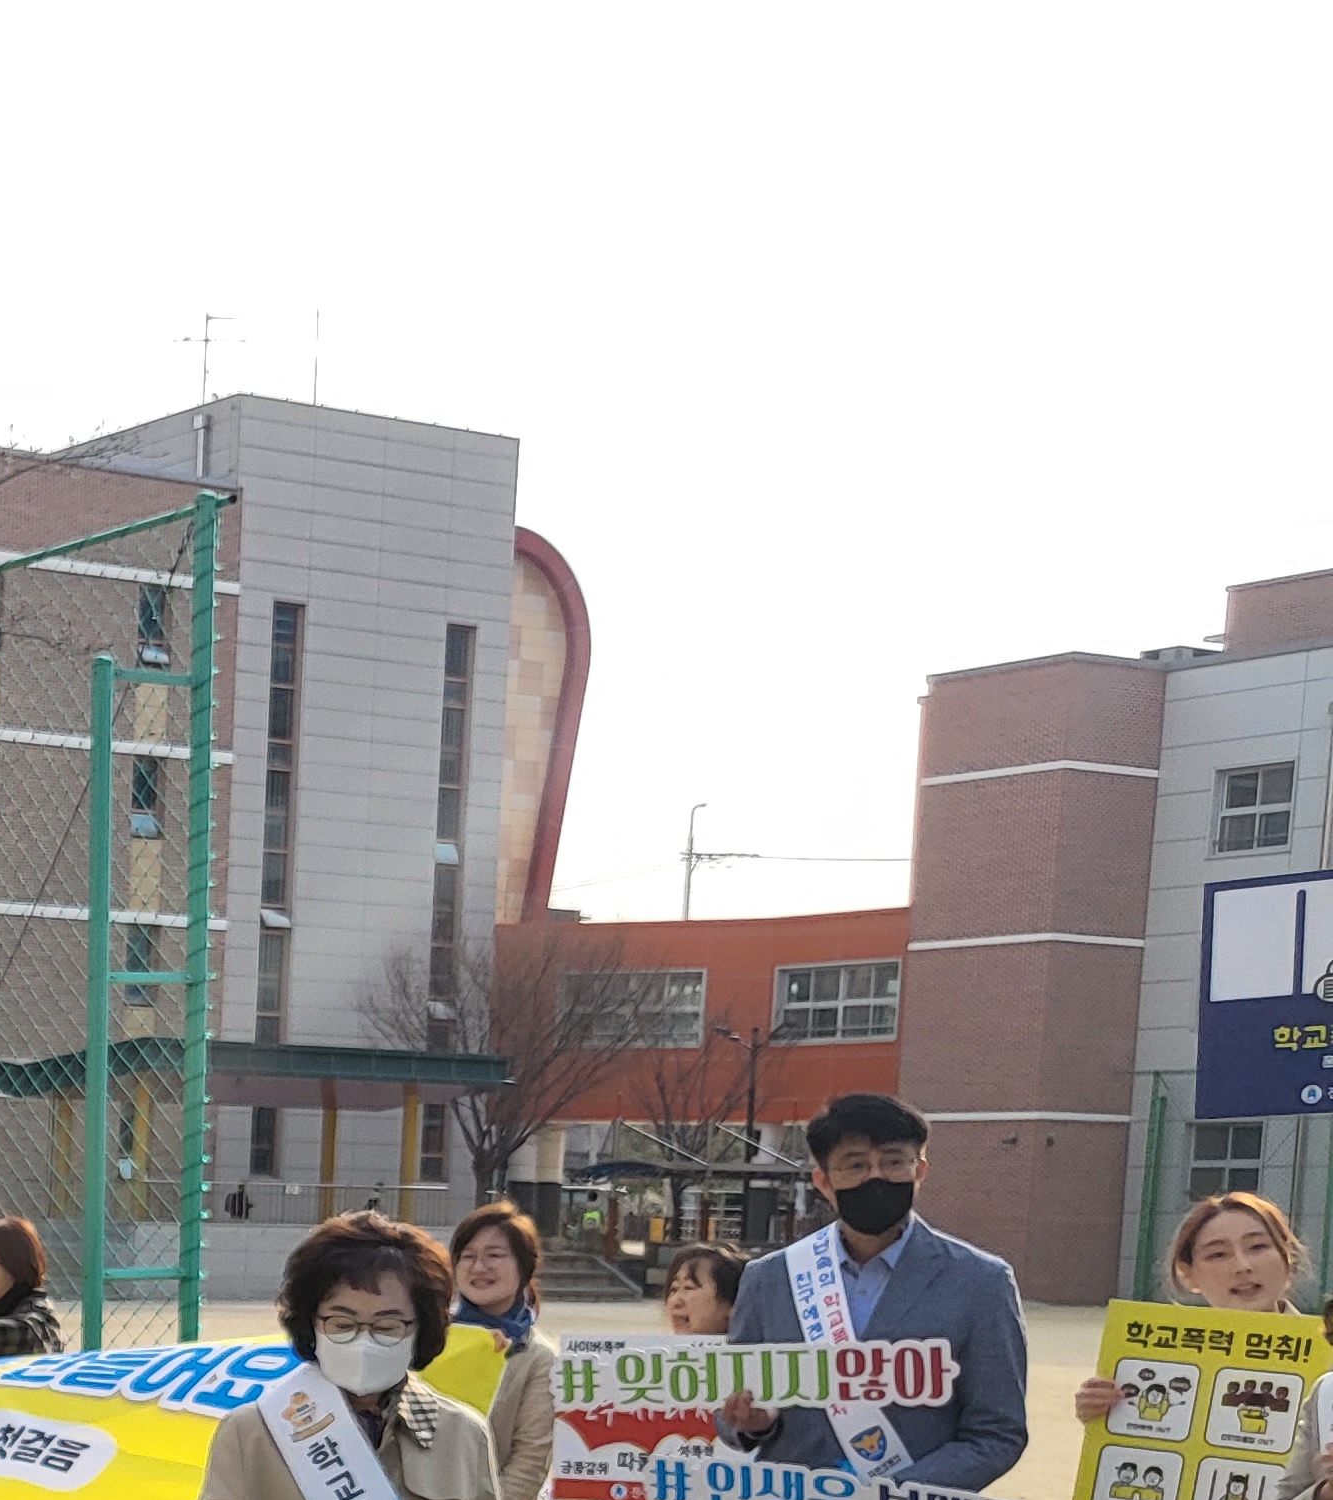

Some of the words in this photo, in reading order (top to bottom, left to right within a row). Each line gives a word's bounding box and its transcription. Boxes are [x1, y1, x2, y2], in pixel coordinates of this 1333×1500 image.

[1273, 1024, 1333, 1052] 학교
[1126, 1321, 1234, 1356] 학교폭력
[1245, 1333, 1313, 1363] 멈춰!
